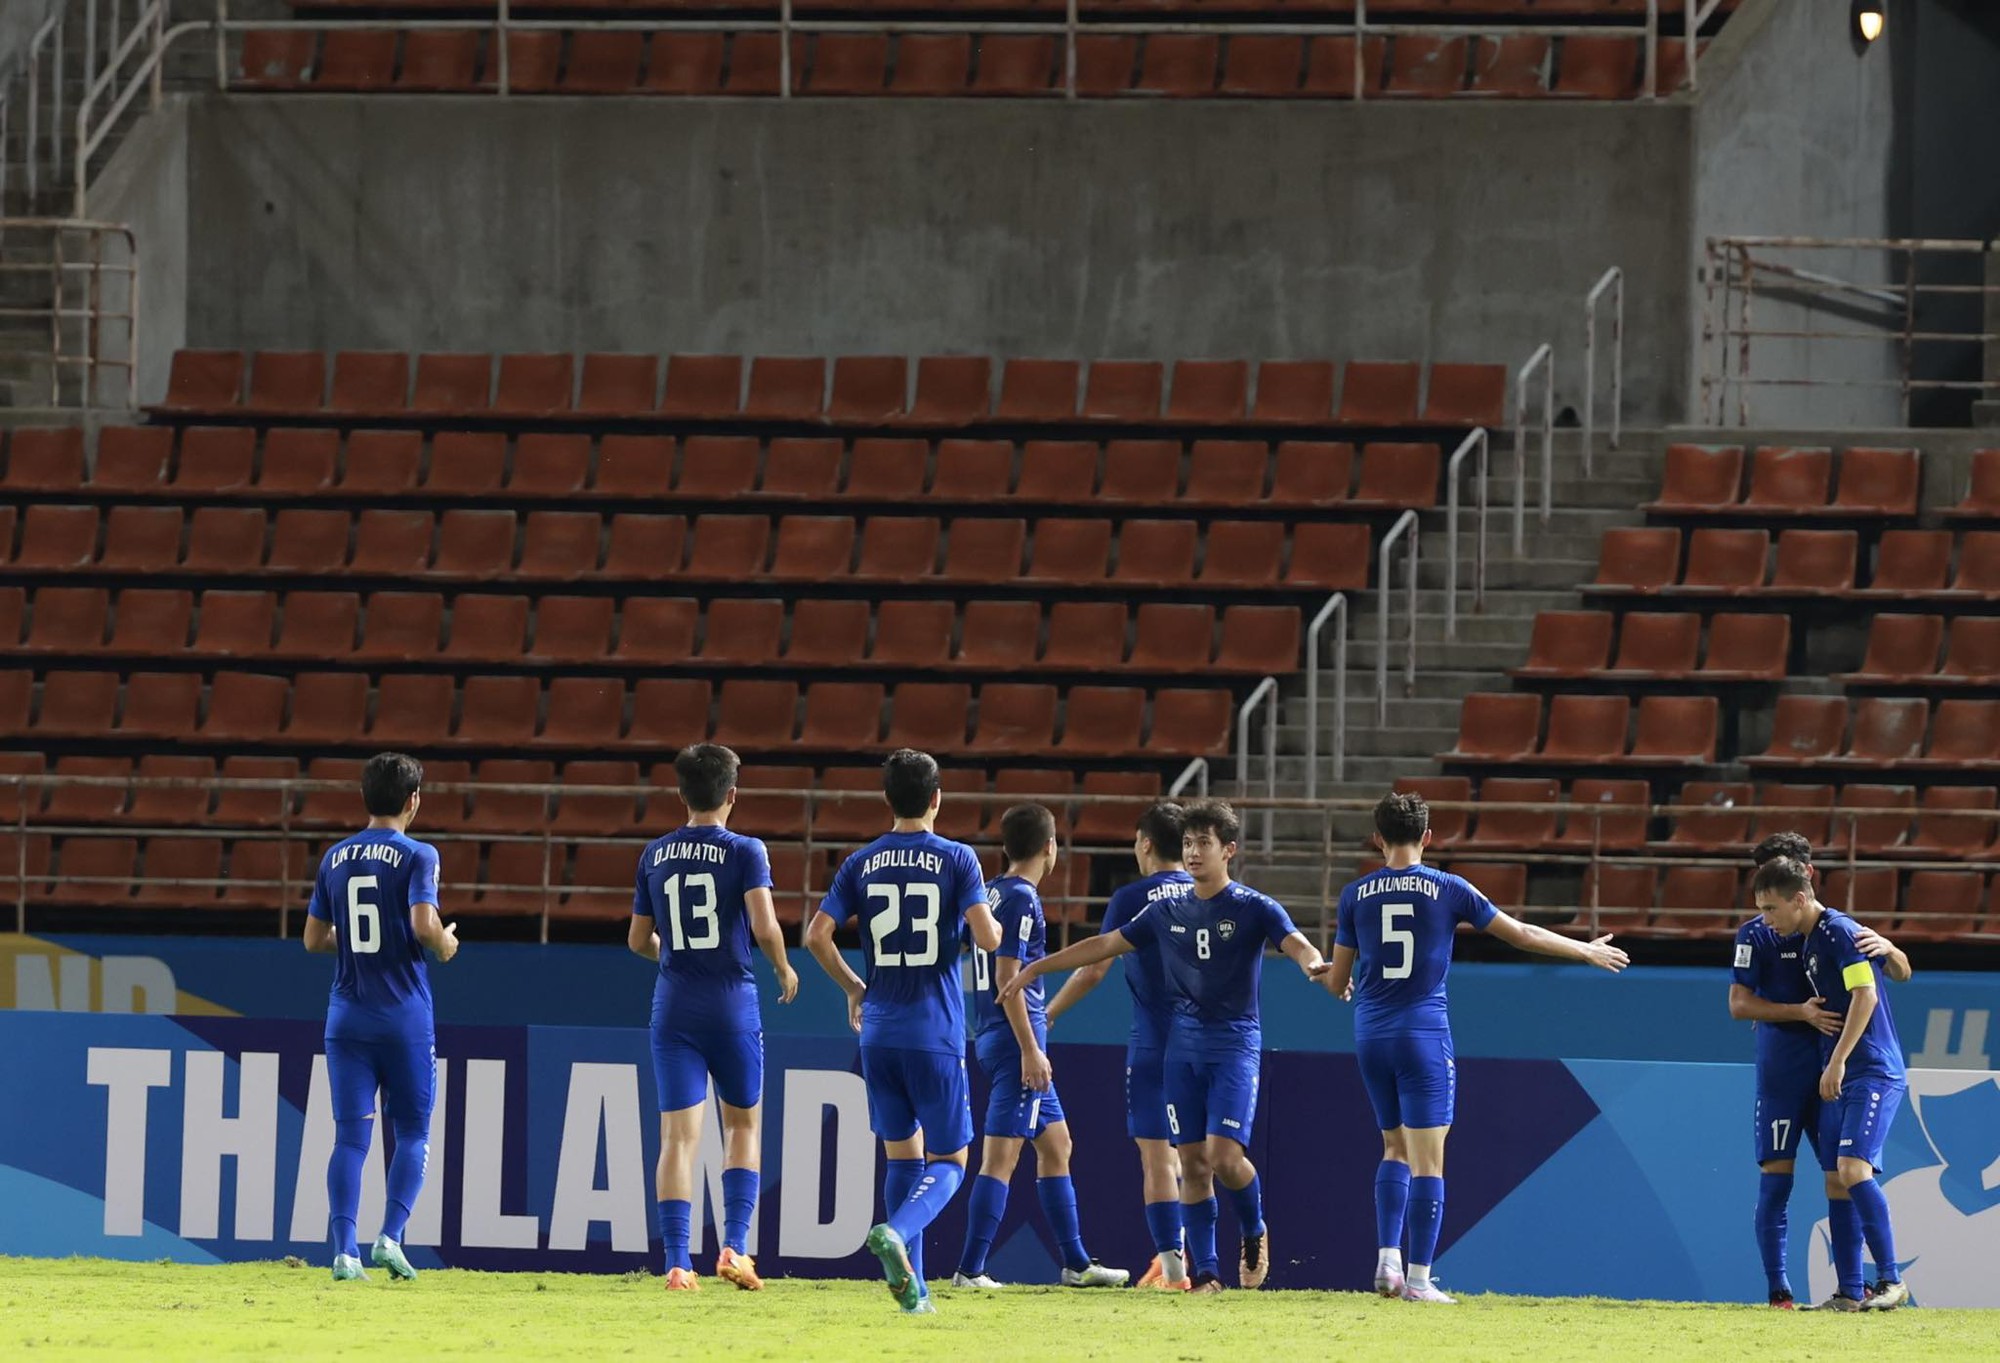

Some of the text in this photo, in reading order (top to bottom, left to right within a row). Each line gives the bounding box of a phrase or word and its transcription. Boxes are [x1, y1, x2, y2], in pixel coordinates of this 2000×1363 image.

[331, 843, 404, 870] UKTAMOV
[653, 842, 727, 867] DJUMATOV
[861, 849, 943, 879] ABDULLAEV
[1356, 875, 1439, 901] TULKUNBEKOV
[347, 874, 381, 954] 6
[663, 873, 720, 951] 13
[866, 882, 941, 967] 23
[1196, 928, 1211, 960] 8
[1381, 903, 1415, 979] 5
[1166, 1103, 1181, 1135] 8
[1771, 1119, 1791, 1151] 17
